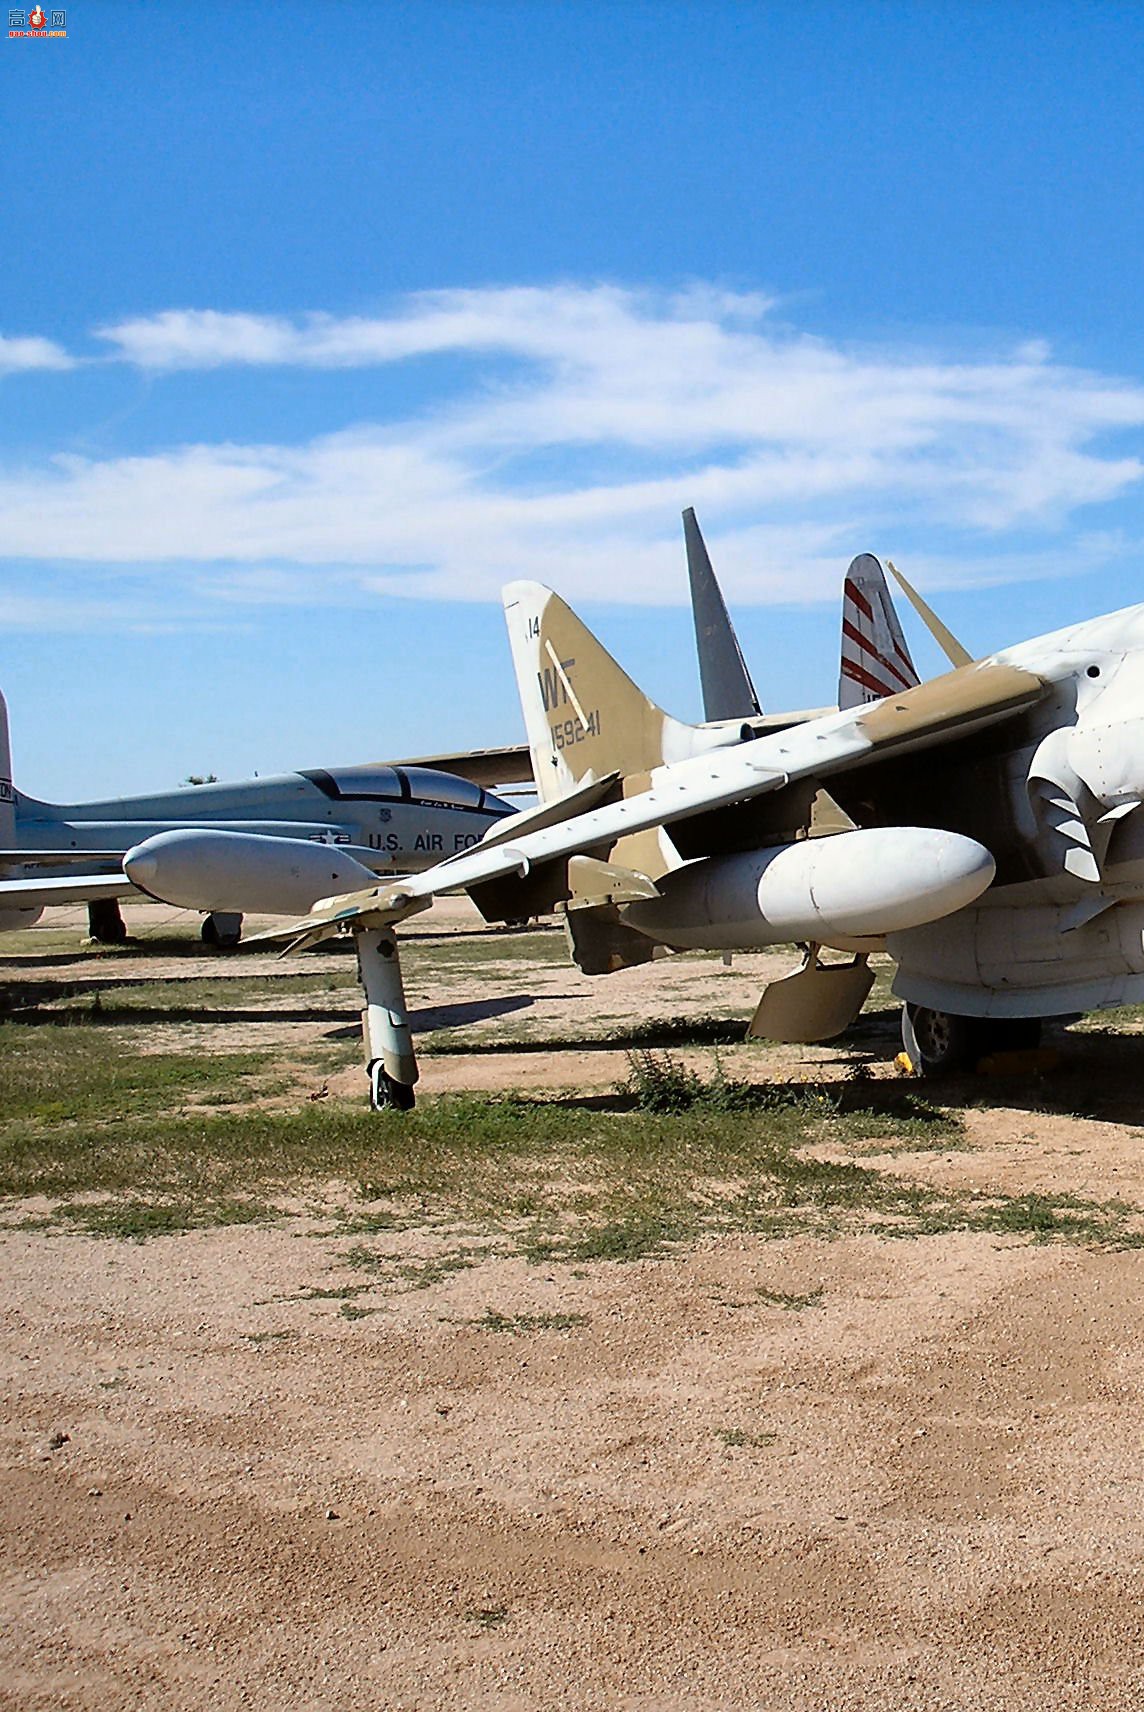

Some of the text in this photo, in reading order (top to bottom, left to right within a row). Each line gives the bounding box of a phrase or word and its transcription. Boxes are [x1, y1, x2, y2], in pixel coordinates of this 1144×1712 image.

[528, 616, 540, 639] 14
[537, 658, 576, 712] WF
[550, 709, 601, 751] 159241
[368, 833, 403, 851] U.S.
[414, 834, 443, 850] AIR
